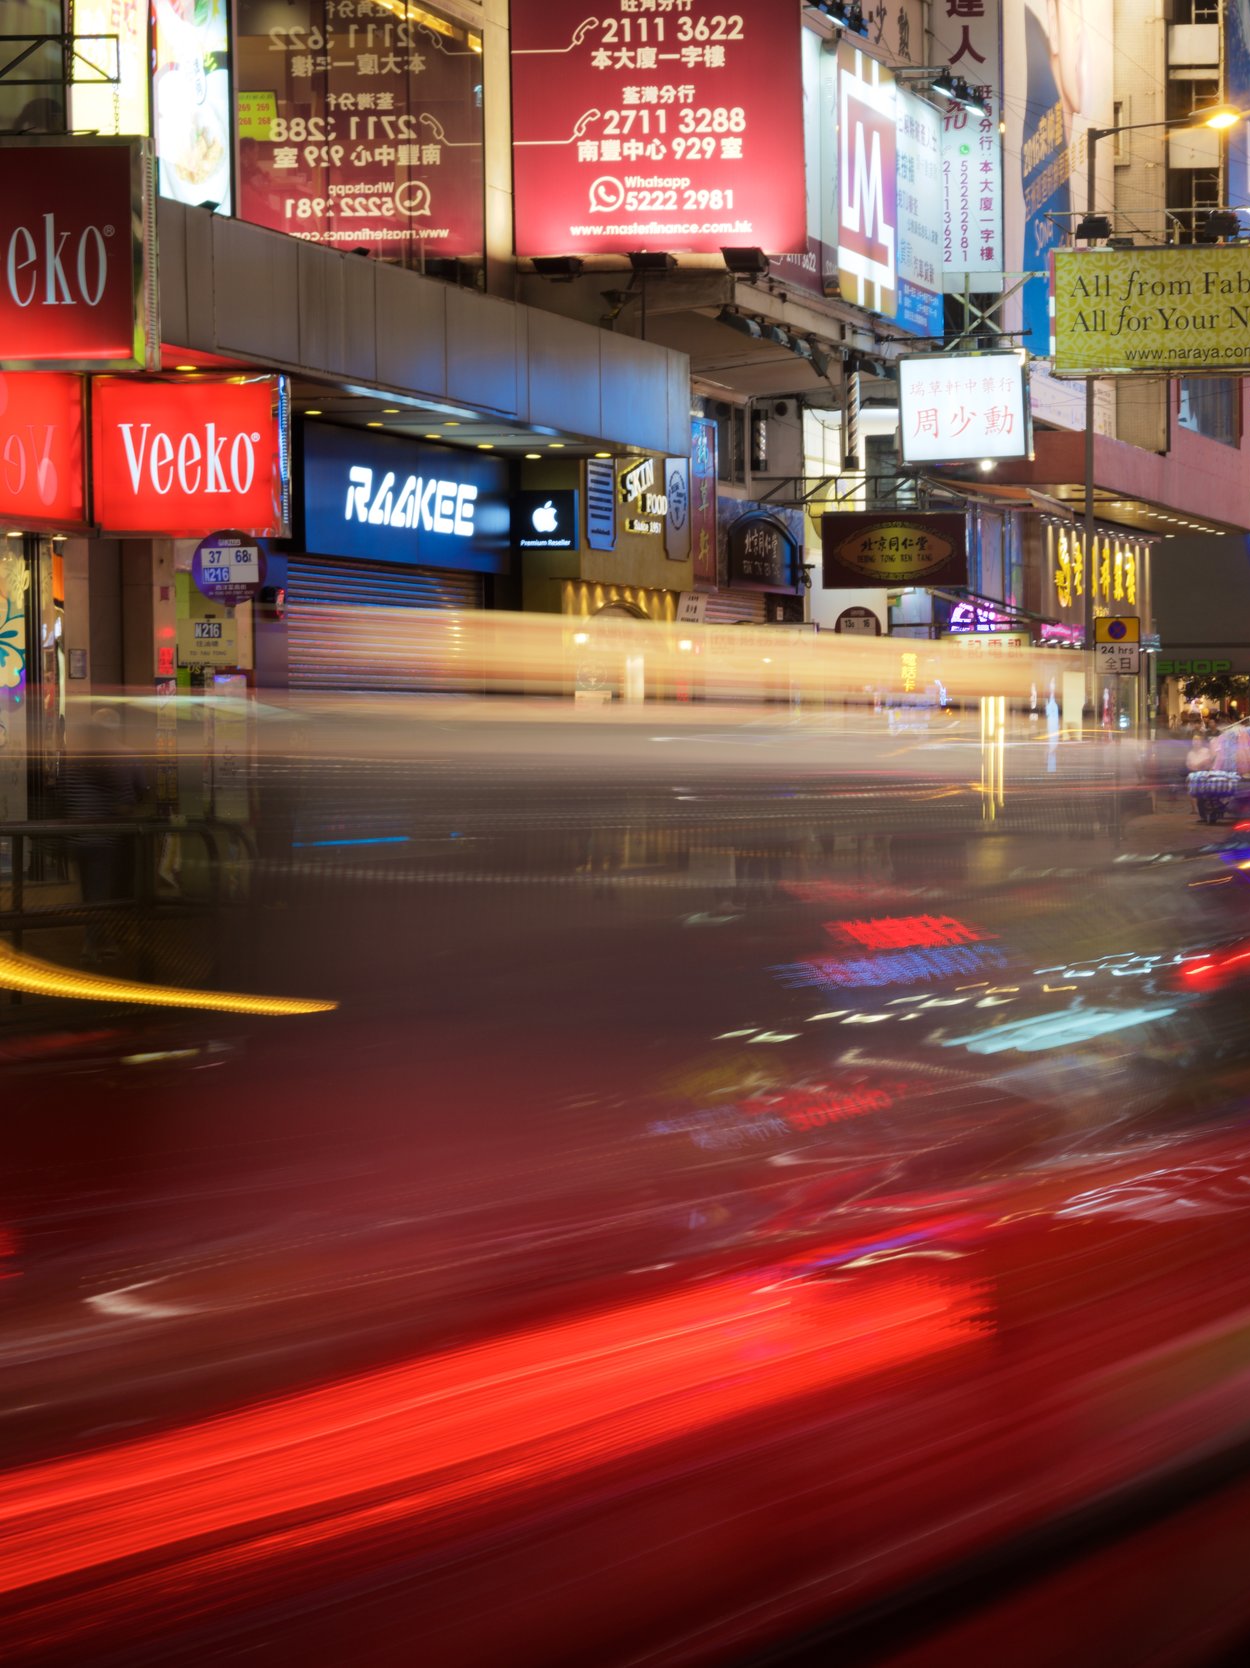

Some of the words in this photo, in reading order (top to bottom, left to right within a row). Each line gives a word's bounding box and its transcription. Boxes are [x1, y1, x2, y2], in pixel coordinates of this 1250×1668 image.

[601, 17, 665, 43] 2111
[677, 15, 744, 42] 3622
[591, 46, 726, 70] 本大廈一字樓
[622, 85, 696, 105] 荃灣分行
[603, 109, 666, 135] 2711
[678, 107, 746, 133] 3288
[671, 137, 717, 160] 929
[720, 137, 743, 159] 室
[624, 176, 691, 190] Whatsapp
[625, 191, 678, 212] 5222
[682, 189, 734, 211] 2981
[570, 221, 753, 237] www.masterfinance.com.hk
[7, 212, 108, 308] eko
[1070, 274, 1111, 298] All
[1119, 270, 1192, 302] from
[1070, 310, 1107, 333] All
[1111, 306, 1154, 337] for
[1159, 306, 1220, 331] Your
[118, 422, 255, 496] Veeko
[625, 458, 654, 502] SKIN
[520, 539, 547, 547] Premium
[548, 539, 571, 547] Reseller
[861, 536, 929, 552] 北京同仁堂
[208, 550, 222, 564] 37
[203, 567, 230, 582] N216
[194, 623, 220, 638] N216
[1100, 645, 1115, 655] 24
[1118, 645, 1134, 655] hrs
[1105, 656, 1132, 671] 全日
